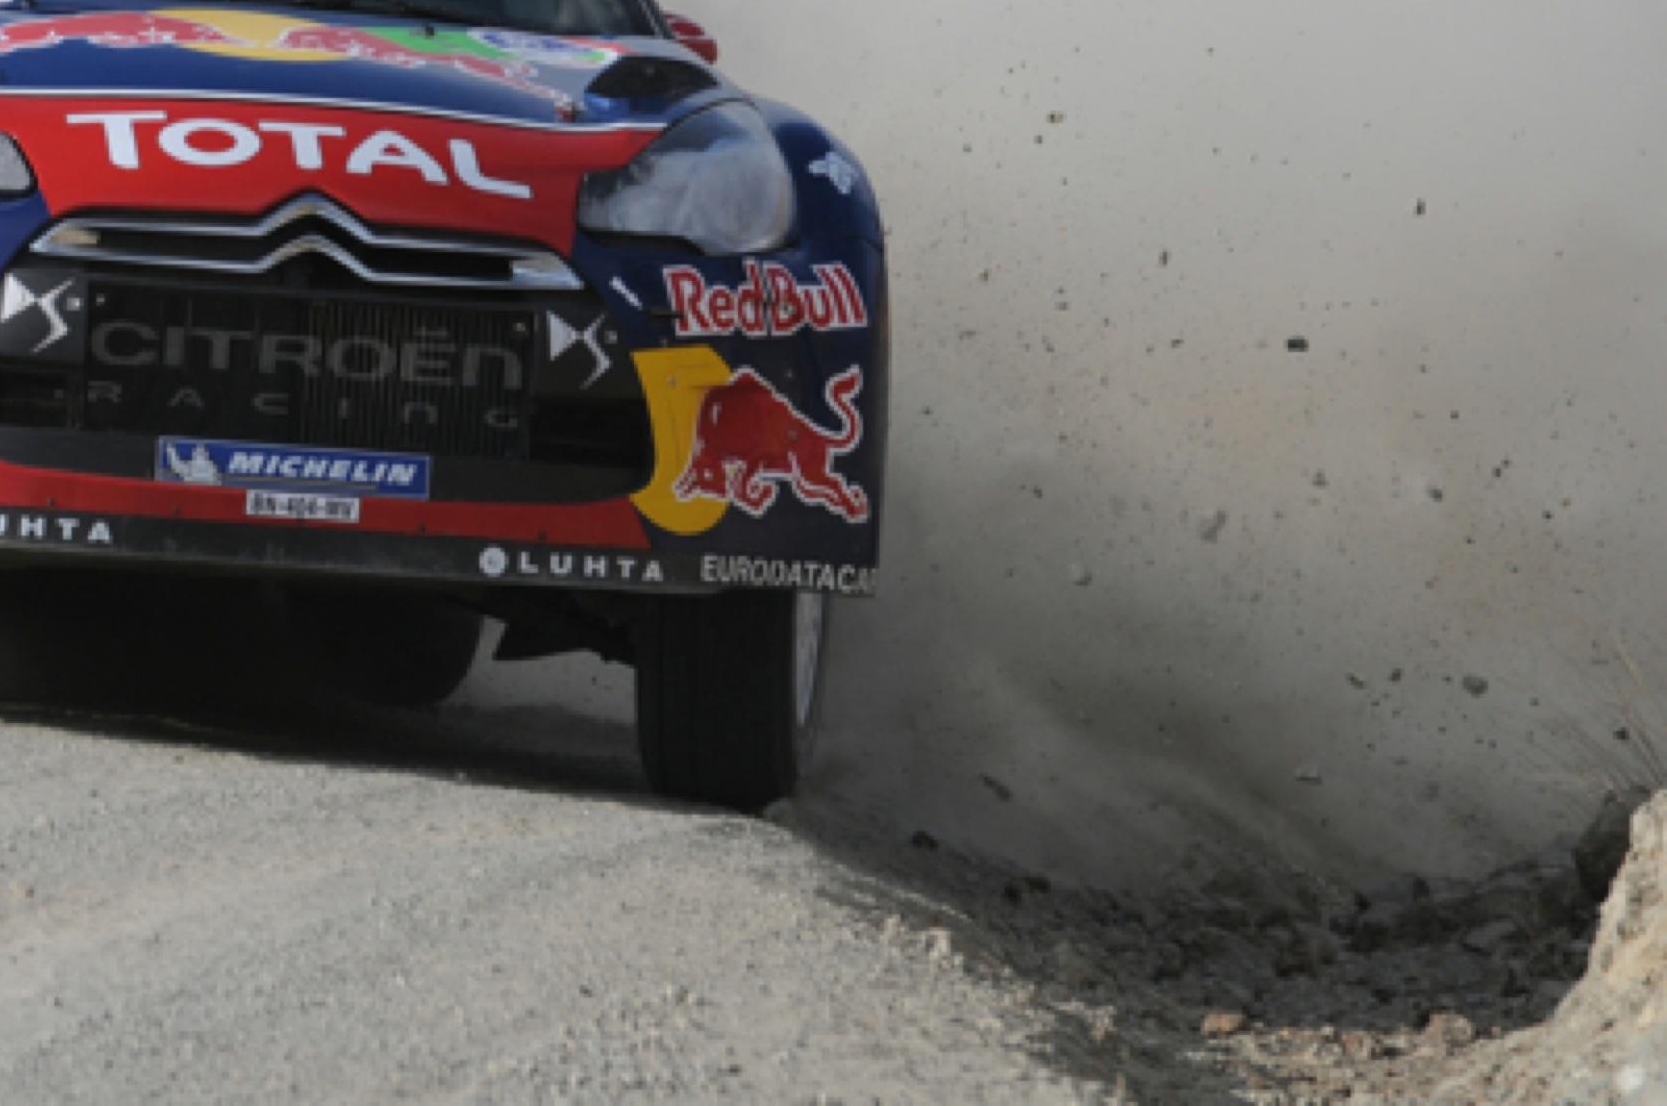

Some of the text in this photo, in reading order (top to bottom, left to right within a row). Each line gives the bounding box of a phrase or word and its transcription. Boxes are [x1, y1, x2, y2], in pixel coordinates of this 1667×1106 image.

[65, 110, 531, 199] TOTAL
[229, 451, 417, 486] MICHELIN
[518, 551, 663, 582] LUHTA
